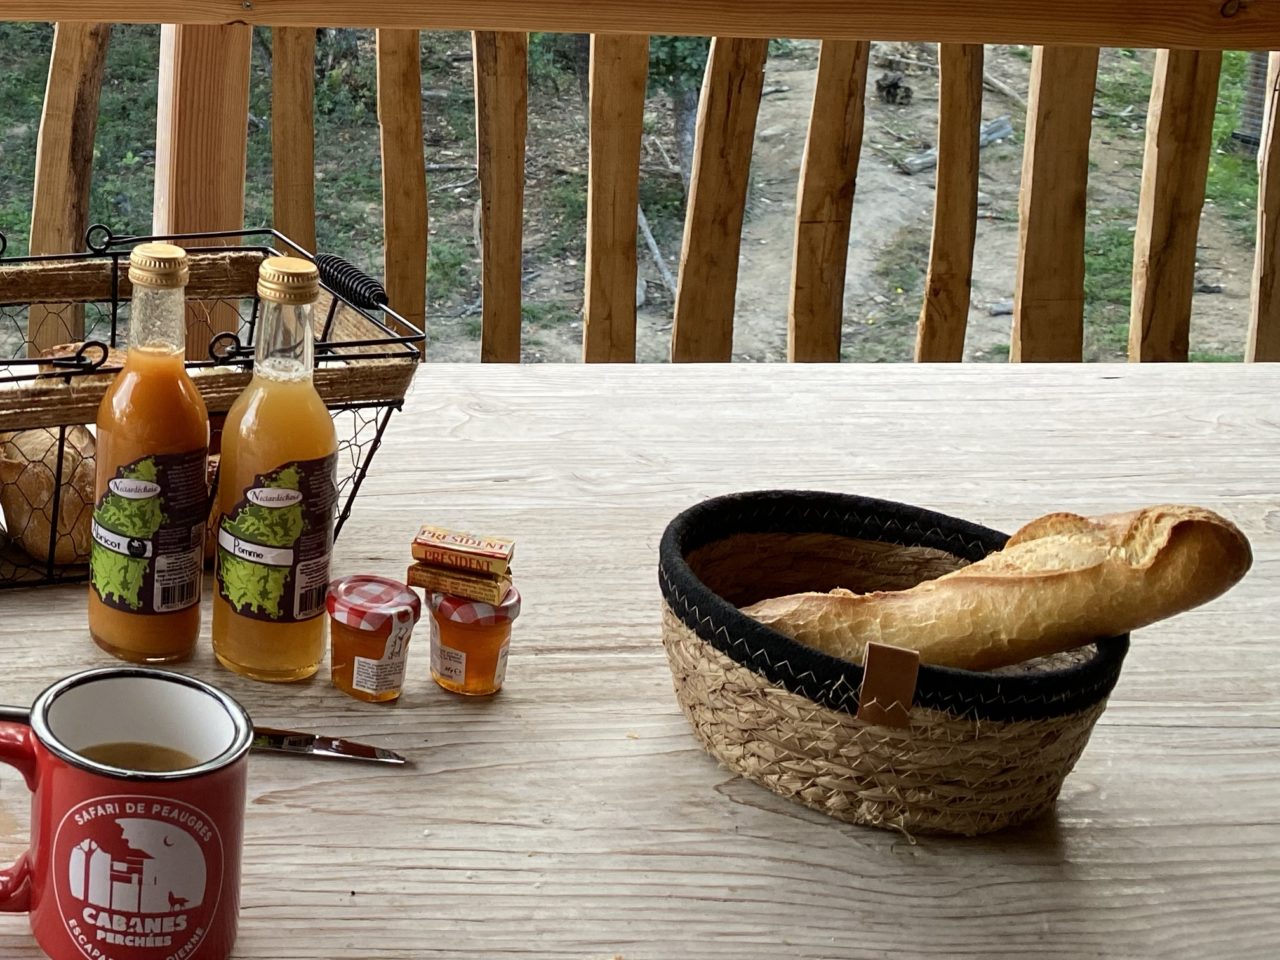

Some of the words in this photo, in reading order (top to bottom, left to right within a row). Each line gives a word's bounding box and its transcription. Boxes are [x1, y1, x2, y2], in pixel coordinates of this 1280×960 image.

[93, 522, 121, 550] Abricot
[233, 538, 264, 559] Pomme
[74, 803, 120, 826] SAFARI
[125, 803, 145, 814] DE
[151, 803, 213, 842] PEAUGRES
[82, 907, 188, 934] CABANES
[68, 918, 115, 960] ESCAPA
[96, 929, 172, 948] PERCHÉES
